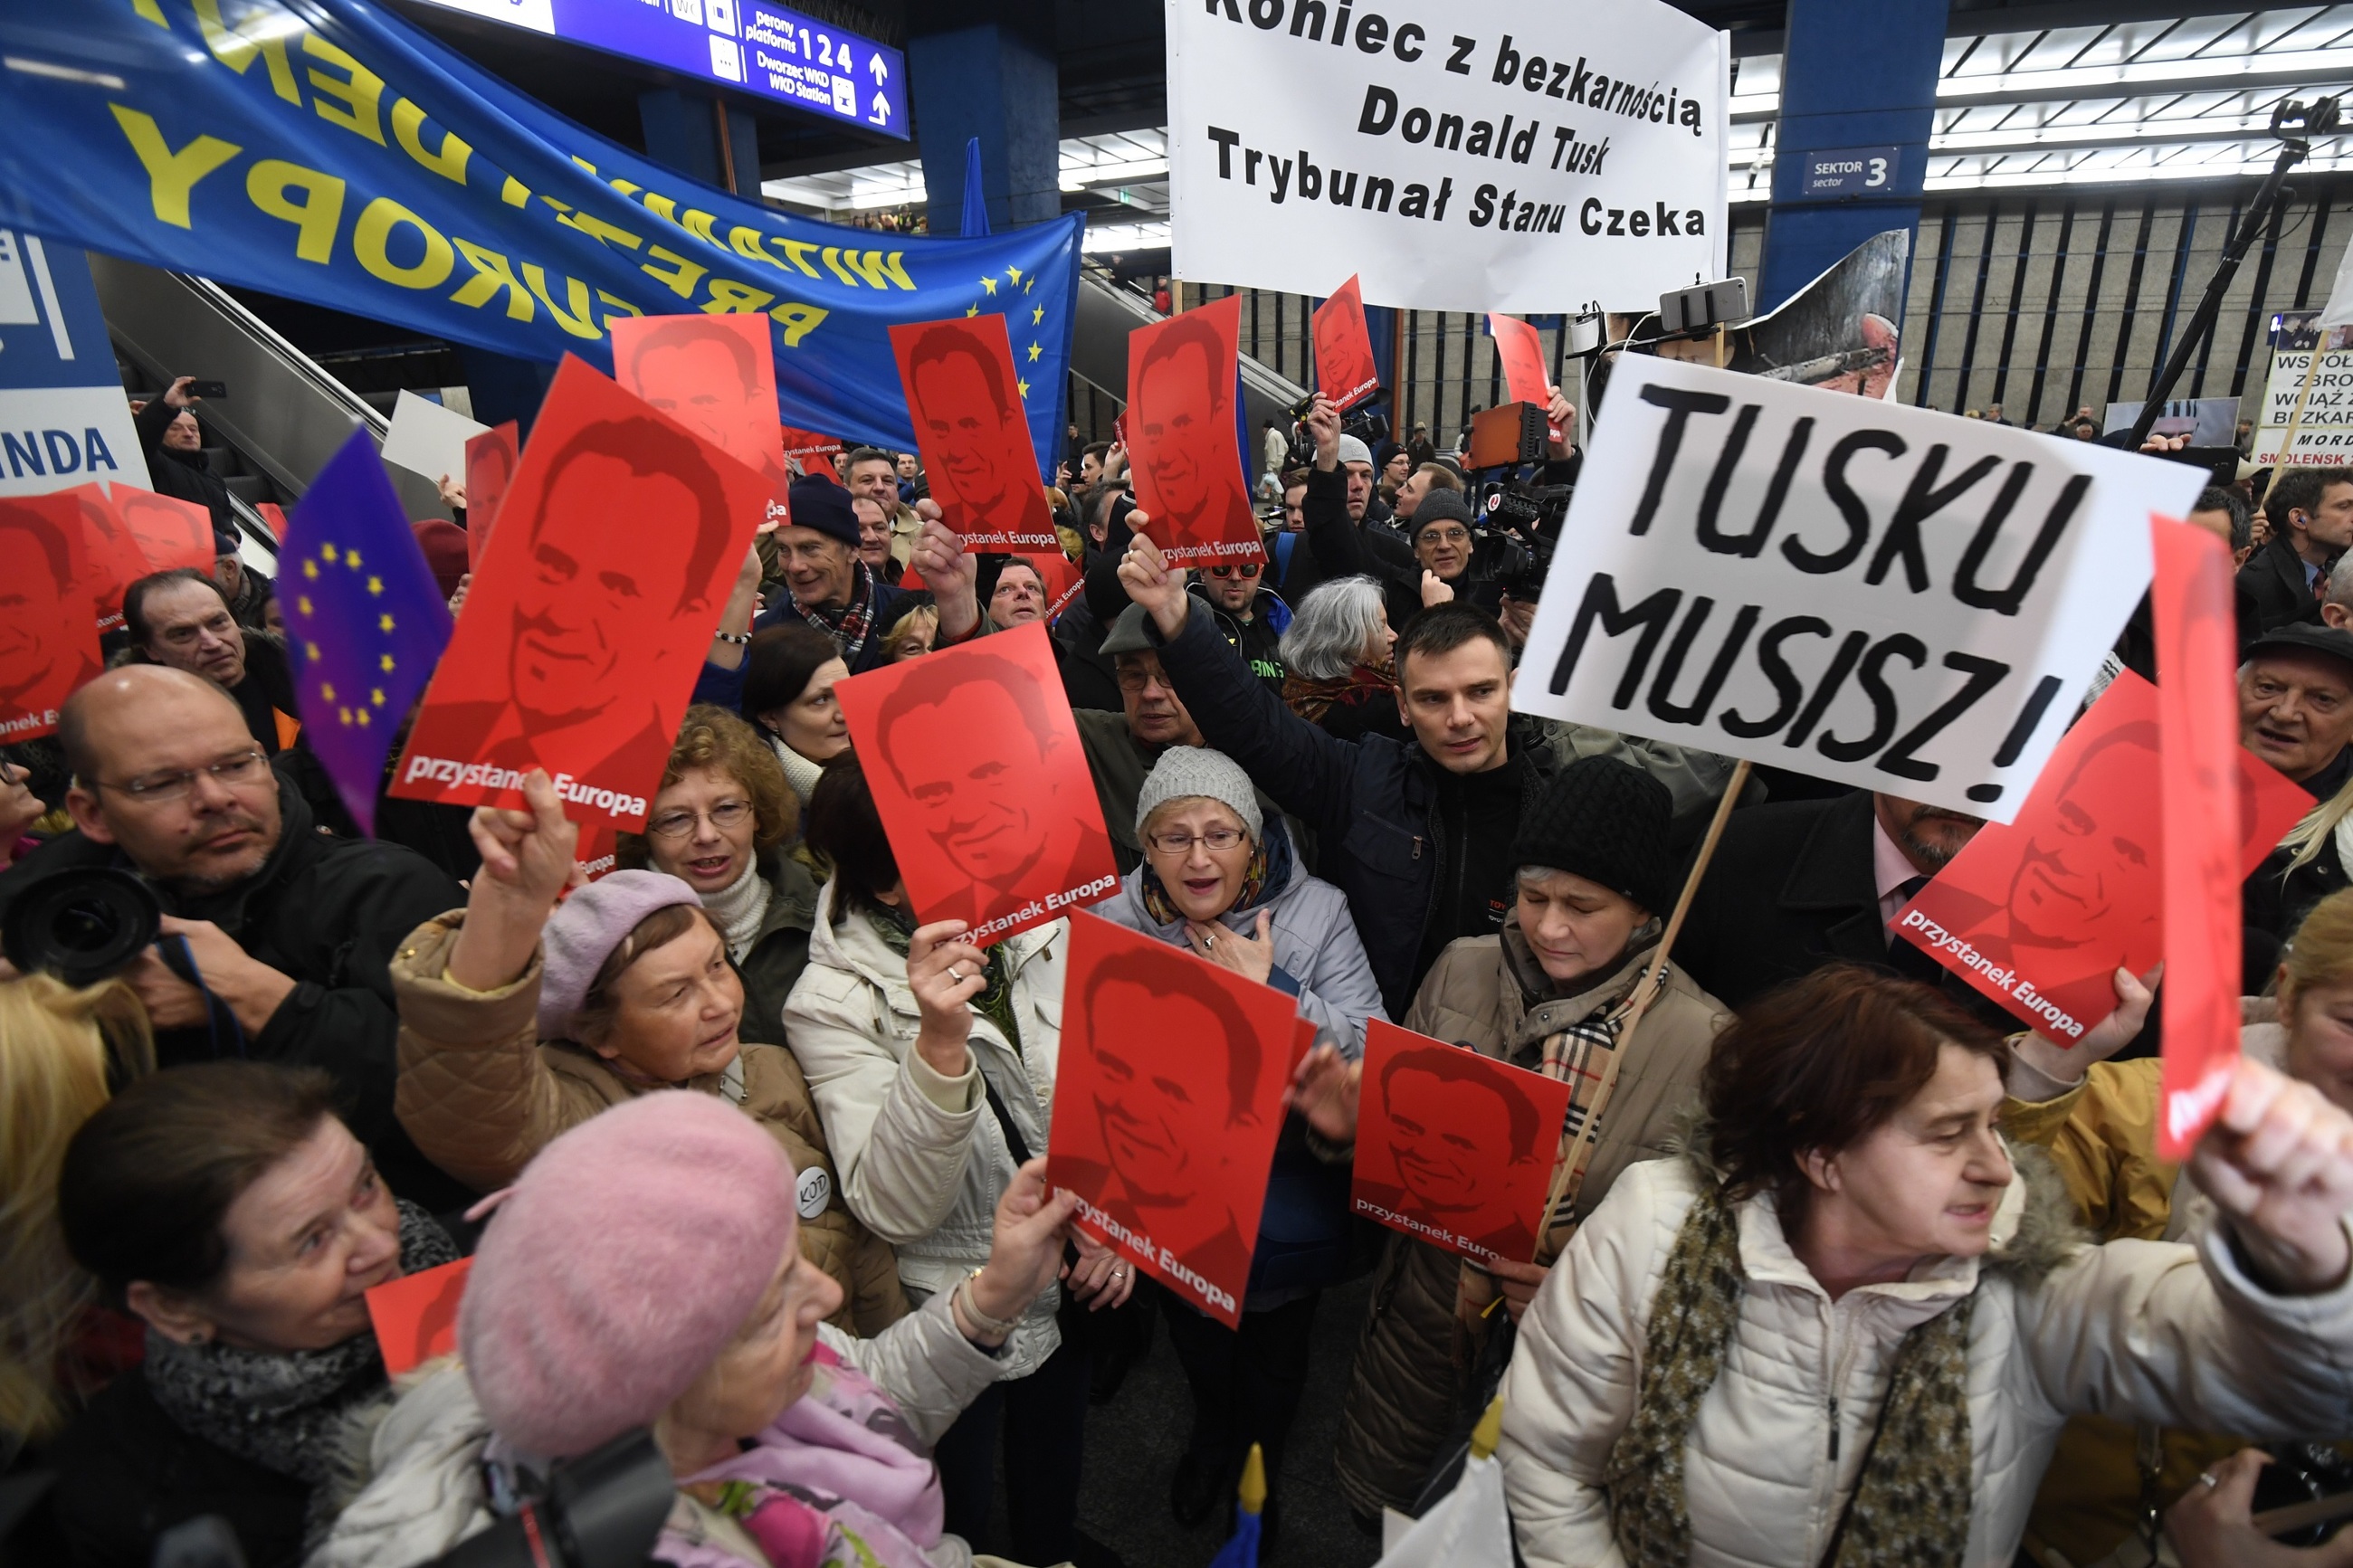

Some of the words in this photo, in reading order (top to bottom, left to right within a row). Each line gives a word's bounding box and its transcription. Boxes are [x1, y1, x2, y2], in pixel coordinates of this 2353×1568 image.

[745, 24, 796, 54] platforms
[756, 10, 794, 38] perony
[757, 50, 805, 81] Dworzec
[804, 66, 830, 88] WKD
[798, 28, 812, 61] 1
[817, 33, 834, 67] 2
[837, 43, 853, 74] 4
[1205, 0, 1426, 62] oniec
[1444, 34, 1477, 76] z
[1491, 34, 1702, 137] bezkarnością
[769, 72, 795, 94] WKD
[795, 81, 831, 106] Station
[1358, 84, 1540, 165] Donald
[1550, 126, 1611, 176] Tusk
[1208, 125, 1453, 222] Trybunał
[1469, 184, 1567, 233] Stanu
[1580, 197, 1705, 237] Czeka
[1812, 177, 1843, 187] sector
[1815, 161, 1862, 175] SEKTOR
[1864, 157, 1888, 187] 3
[1353, 376, 1377, 396] Europa
[815, 444, 841, 452] Europa
[1629, 384, 2092, 616] TUSKU
[1007, 530, 1056, 547] Europa
[1160, 541, 1215, 562] rzystanek
[1213, 540, 1262, 557] Europa
[1061, 577, 1085, 601] Europa
[1548, 572, 2062, 803] MUSISZ!
[551, 772, 648, 818] Europa
[1045, 874, 1116, 911] Europa
[1901, 909, 2017, 991] przystanek
[2011, 981, 2084, 1038] Europa
[800, 1174, 827, 1206] KOD
[1357, 1198, 1453, 1244] przystanek
[1456, 1235, 1510, 1262] Euro
[1158, 1247, 1237, 1315] Europa
